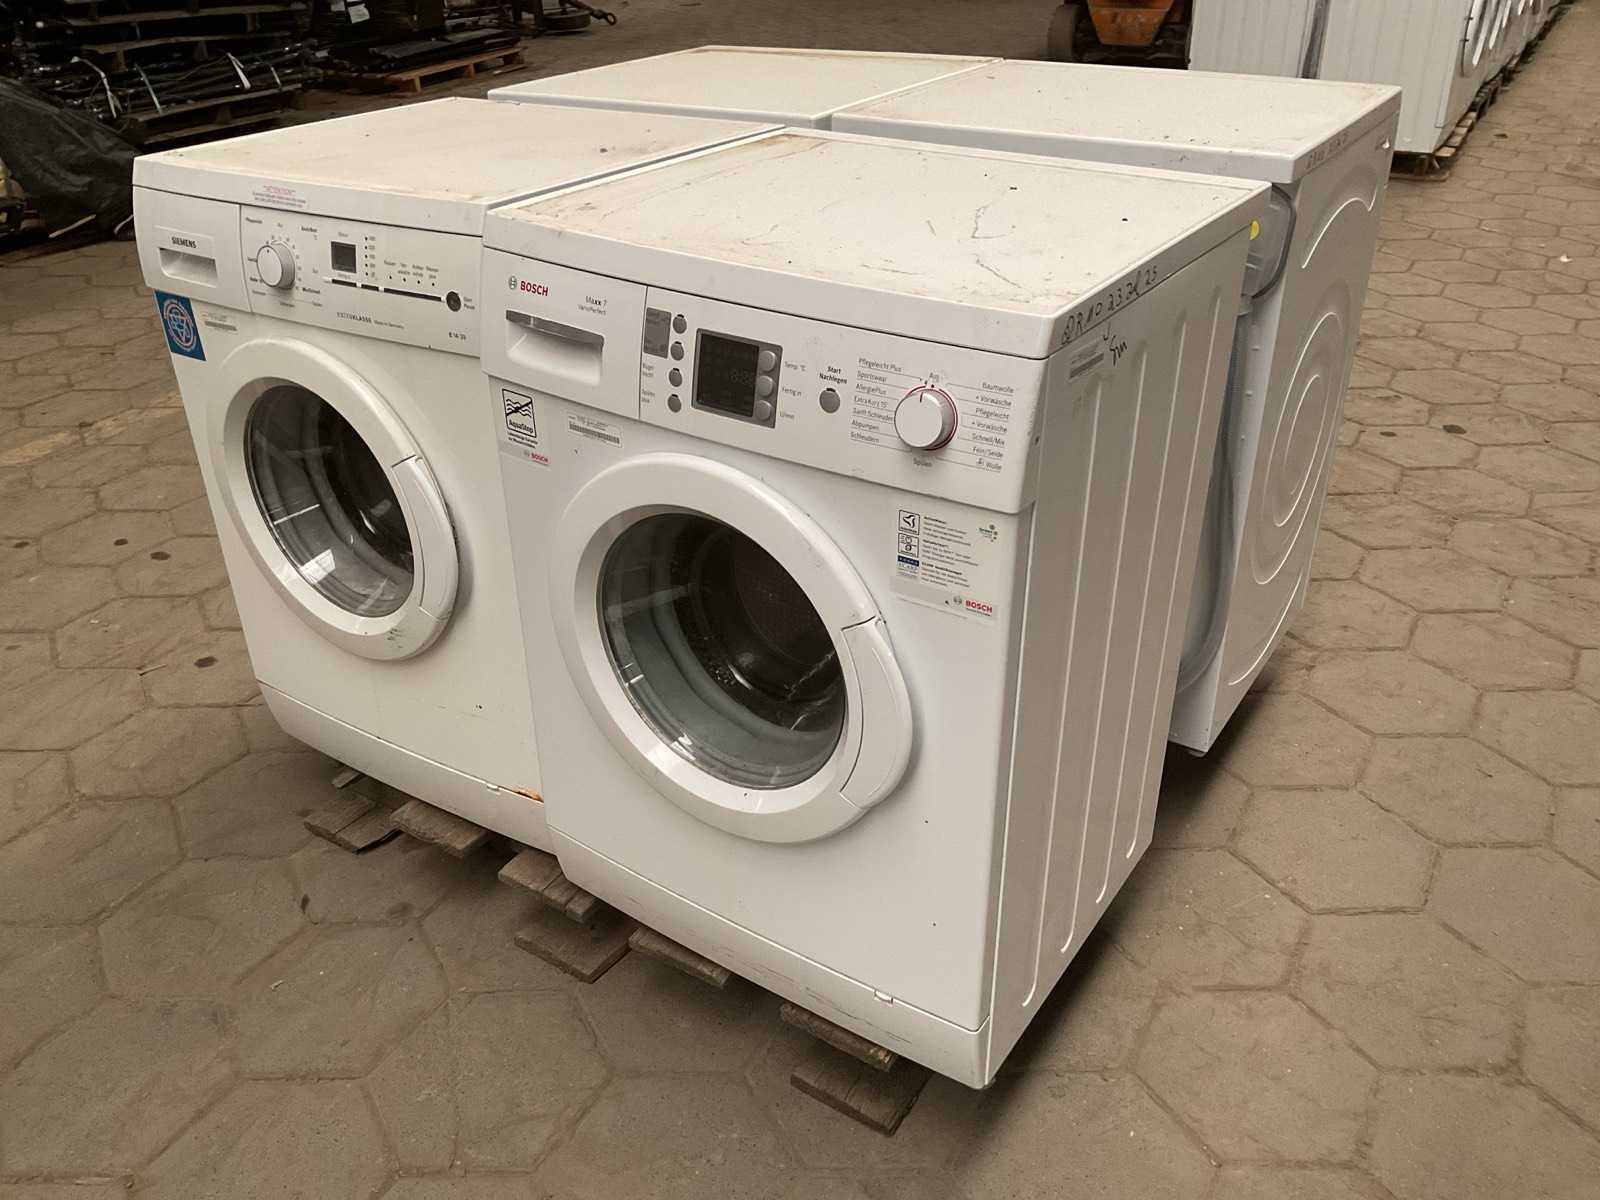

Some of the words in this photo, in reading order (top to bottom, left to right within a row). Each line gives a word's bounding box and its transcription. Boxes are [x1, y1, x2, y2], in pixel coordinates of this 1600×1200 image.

[171, 235, 197, 249] SIEMENS
[520, 280, 549, 296] BOSCH
[585, 295, 602, 306] Maxx
[827, 365, 841, 374] Start
[858, 357, 889, 370] Pflegeleicht
[890, 363, 902, 372] Plus
[819, 372, 848, 385] Nachlegen
[857, 370, 887, 382] Sportswear
[855, 383, 887, 396] AllergiePlus
[982, 382, 1014, 394] Baumwolle
[980, 394, 1012, 407] Vorwäsche
[975, 407, 1009, 420] Pflegeleicht
[508, 418, 534, 434] AquaStop
[851, 419, 880, 430] Abpumpen
[976, 421, 1008, 433] Vorwäsche
[850, 431, 880, 443] Schleudern
[972, 432, 1005, 446] Schnell/Mix
[531, 452, 549, 463] BOSCH
[965, 599, 993, 613] BOSCH
